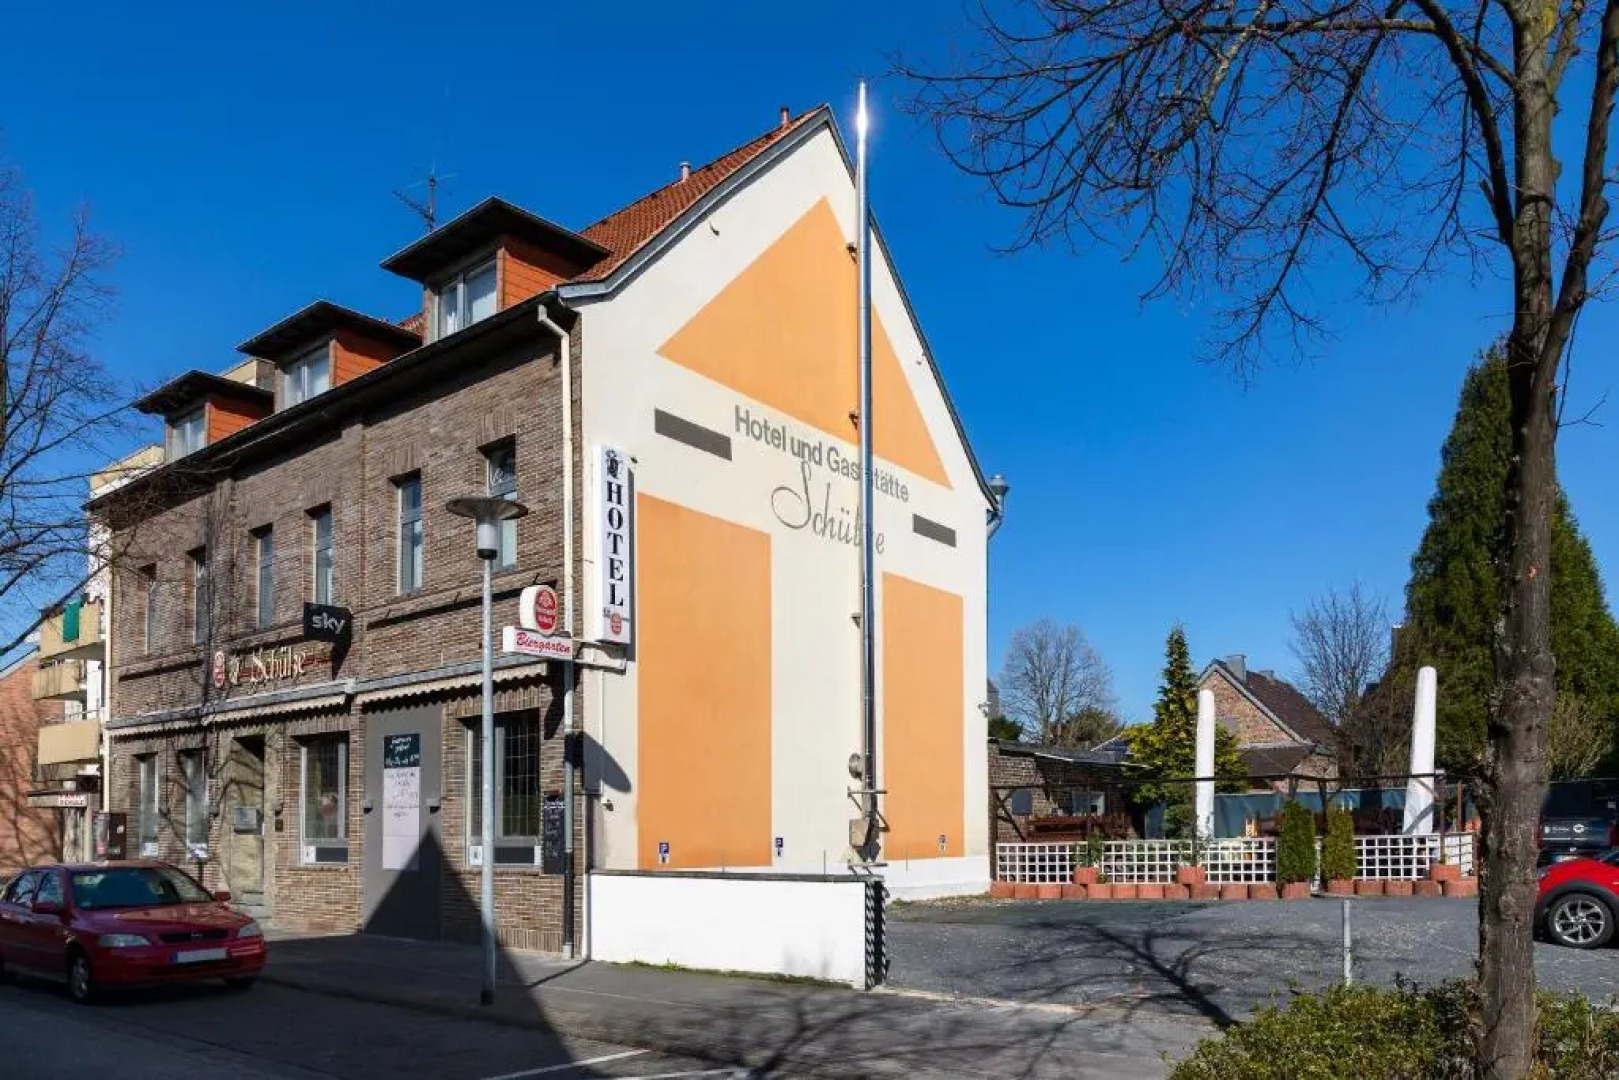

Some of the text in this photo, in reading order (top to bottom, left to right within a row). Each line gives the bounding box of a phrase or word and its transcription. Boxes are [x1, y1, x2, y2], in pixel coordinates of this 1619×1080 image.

[734, 404, 910, 502] Hotel und Gastätte
[606, 480, 625, 607] HOTEL
[312, 611, 346, 634] sky
[515, 632, 571, 654] Biergarten
